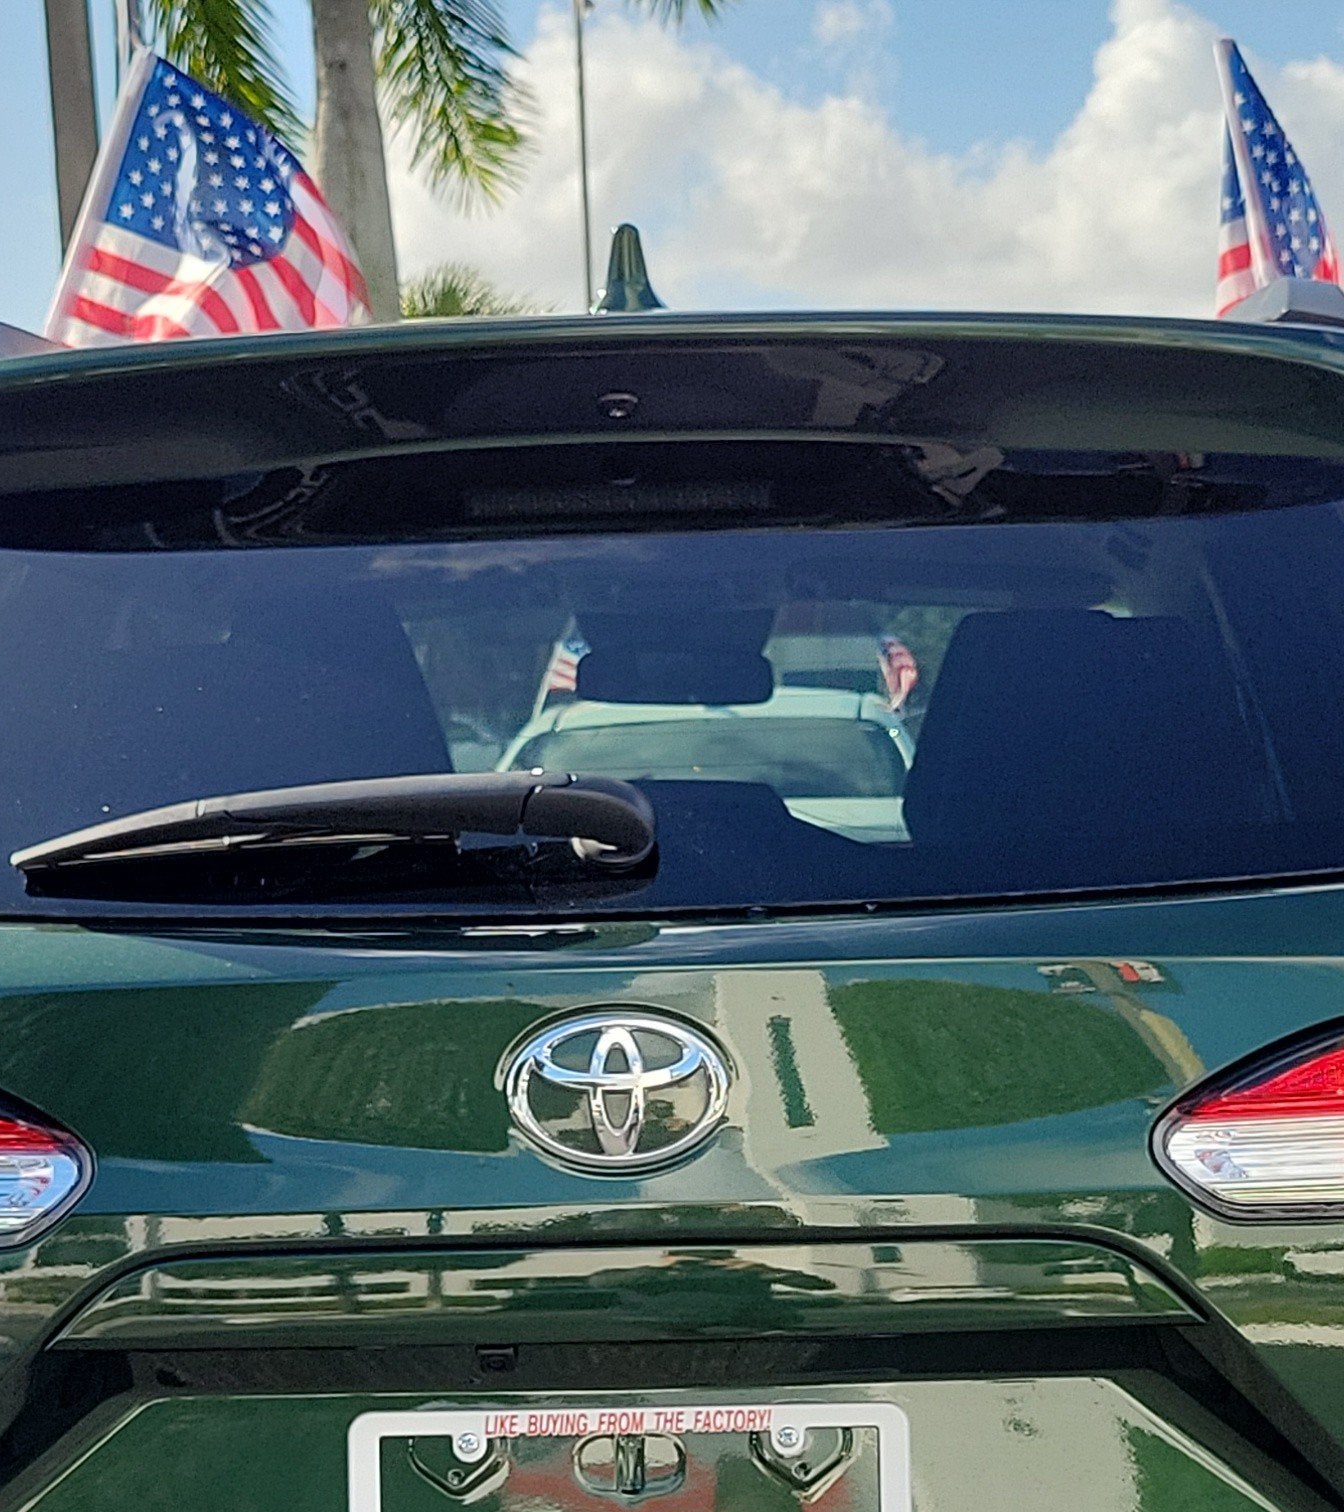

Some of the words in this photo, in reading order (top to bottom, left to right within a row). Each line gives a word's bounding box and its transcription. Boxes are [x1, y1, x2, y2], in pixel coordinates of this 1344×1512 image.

[484, 1414, 519, 1436] LIKE
[528, 1413, 589, 1435] BUYING
[598, 1412, 645, 1434] FROM
[655, 1411, 685, 1433] THE
[693, 1408, 773, 1432] FACTORY!
